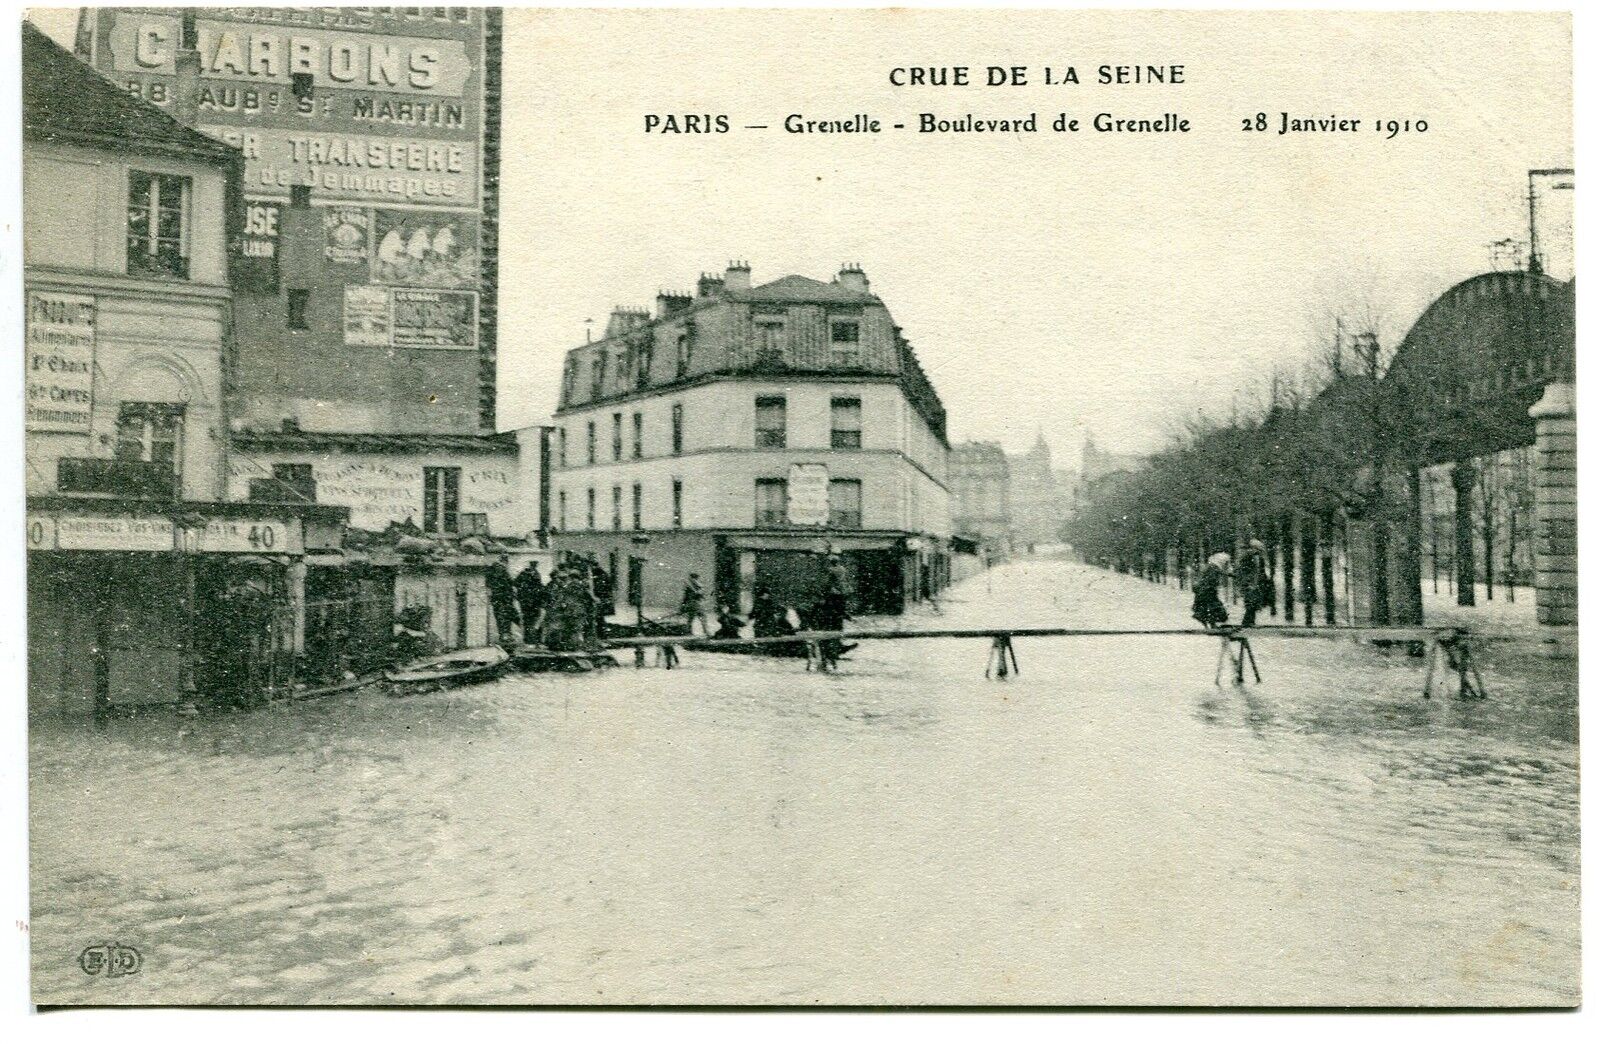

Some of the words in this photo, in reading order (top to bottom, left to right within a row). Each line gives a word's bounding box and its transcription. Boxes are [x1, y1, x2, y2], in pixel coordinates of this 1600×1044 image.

[353, 97, 467, 130] MARTIN
[301, 166, 459, 199] Jemmapes
[247, 524, 275, 549] 40
